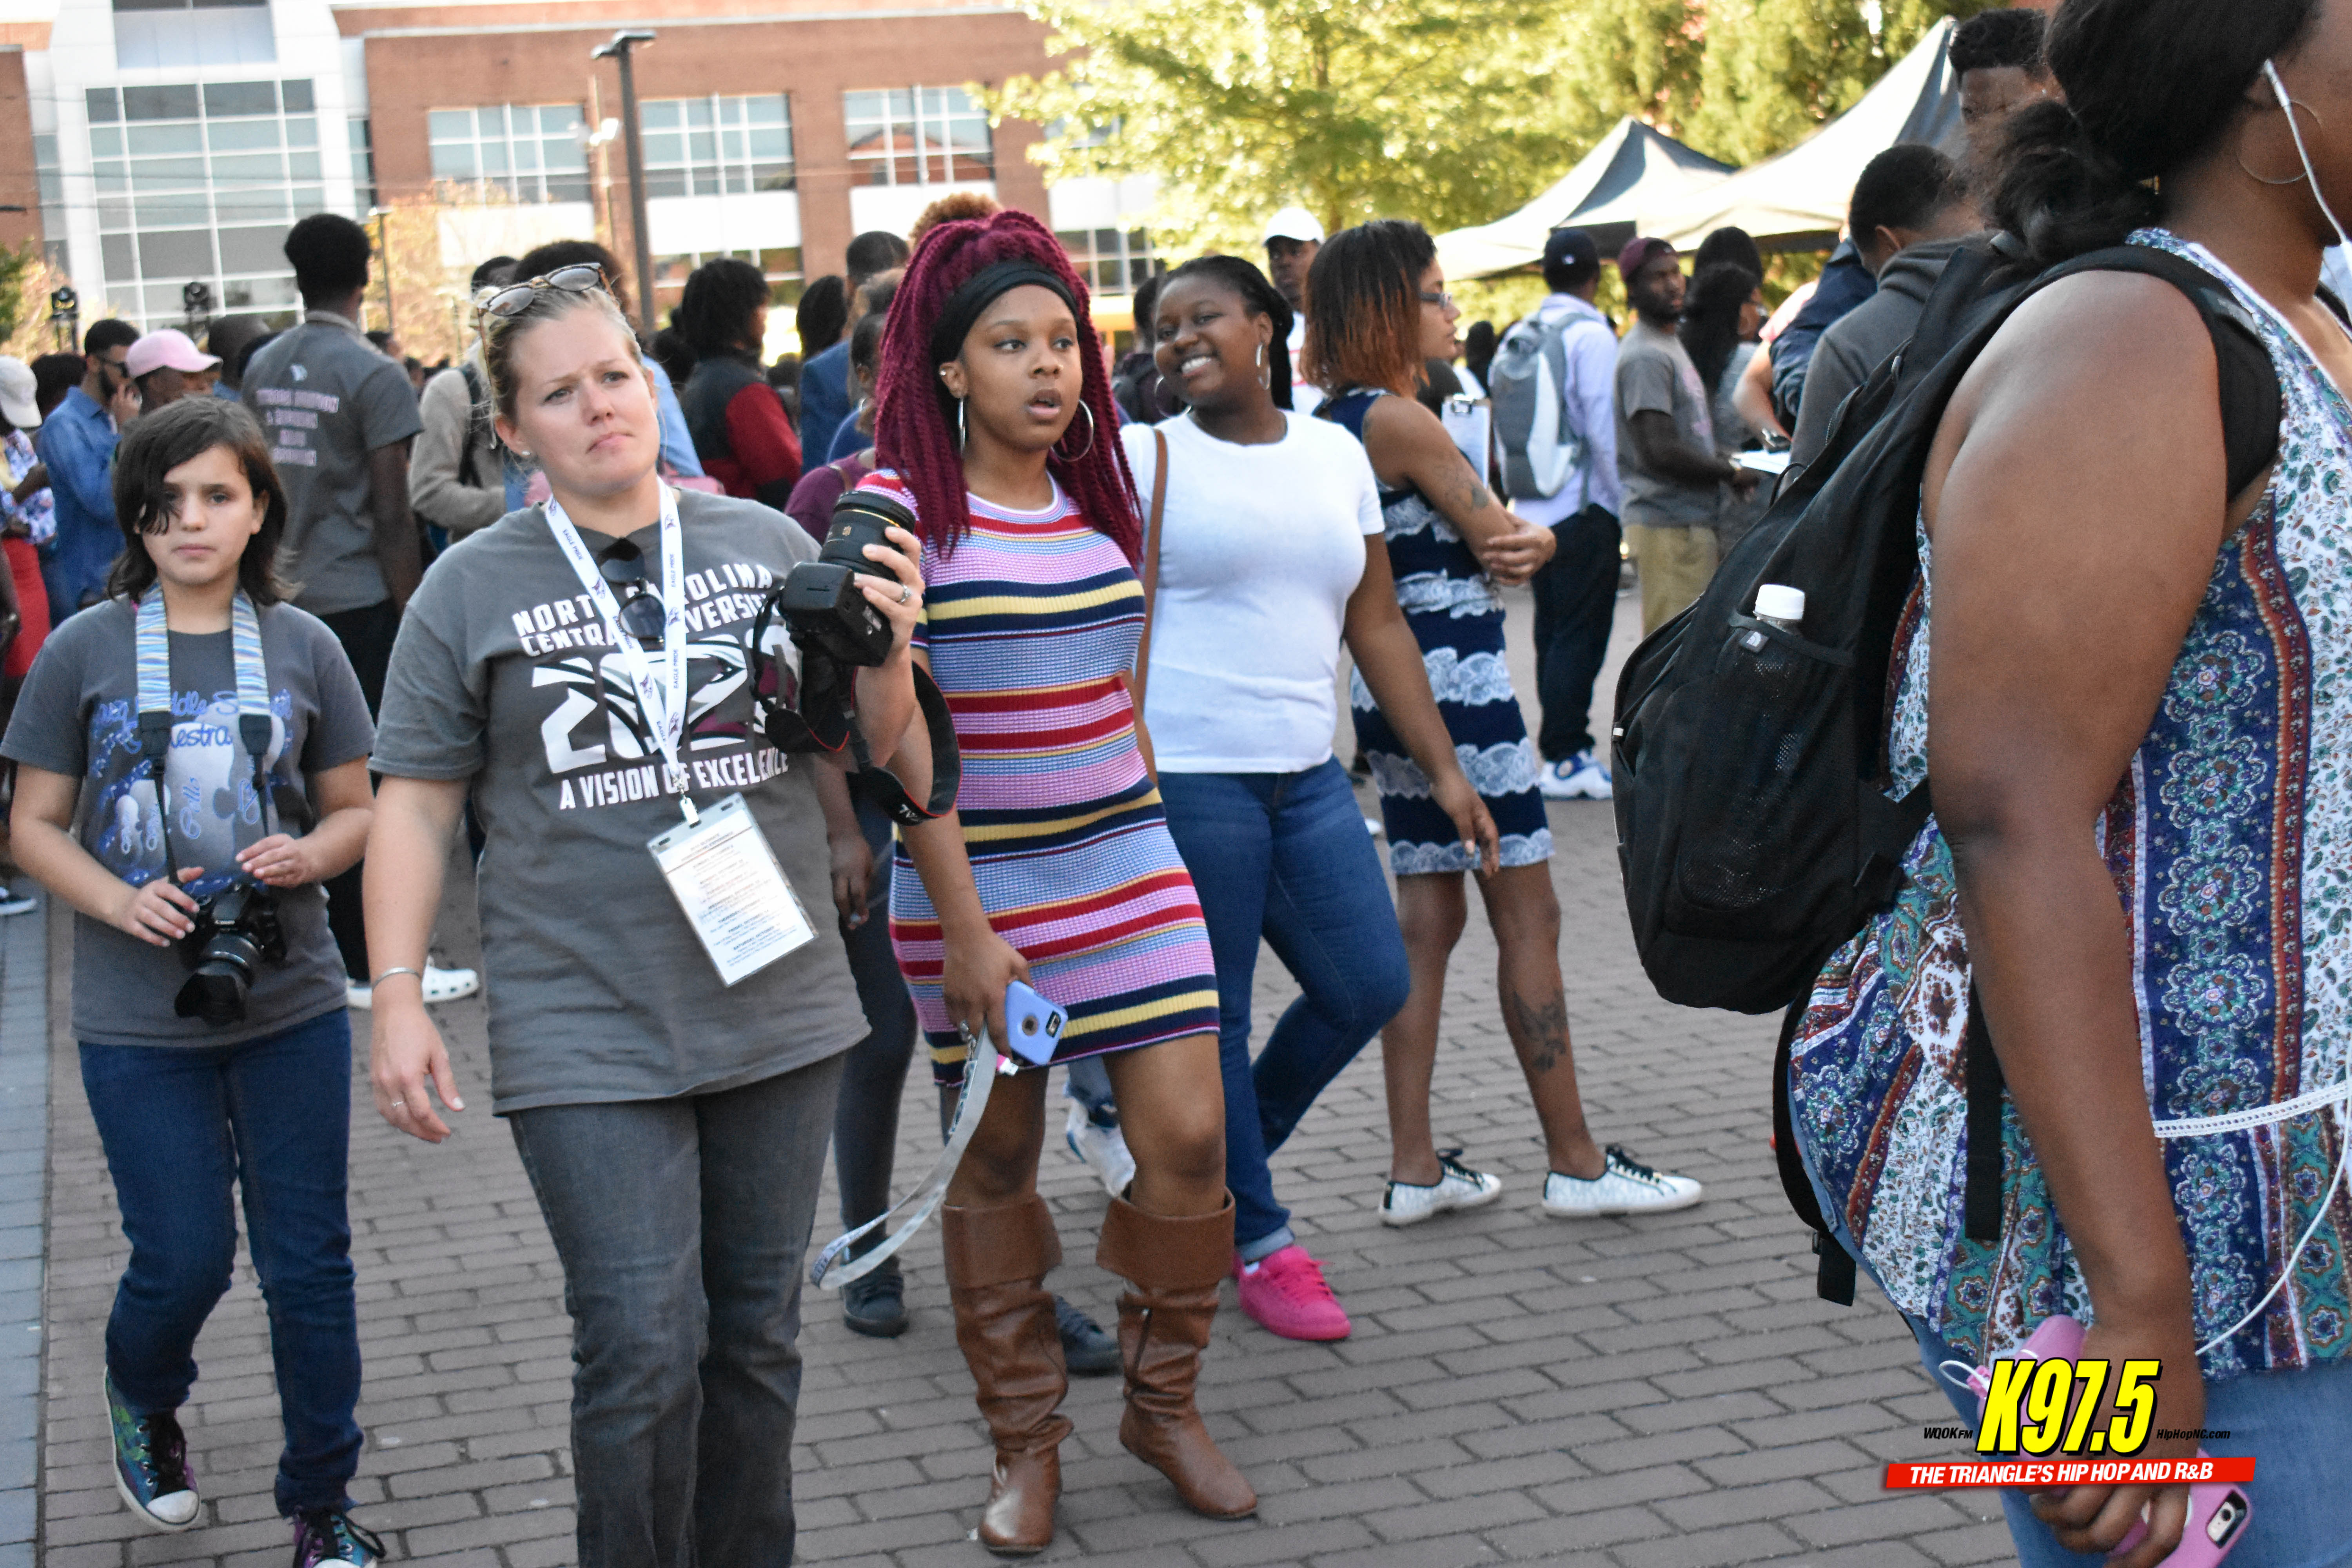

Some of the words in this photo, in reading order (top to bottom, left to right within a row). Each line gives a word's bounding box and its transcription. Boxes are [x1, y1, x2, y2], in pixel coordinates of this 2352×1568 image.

[563, 529, 574, 545] EAGLE
[512, 594, 596, 637] NORT
[521, 623, 619, 657] CENTRA
[560, 779, 576, 810] A
[580, 765, 659, 808] VISION
[662, 762, 691, 794] OF
